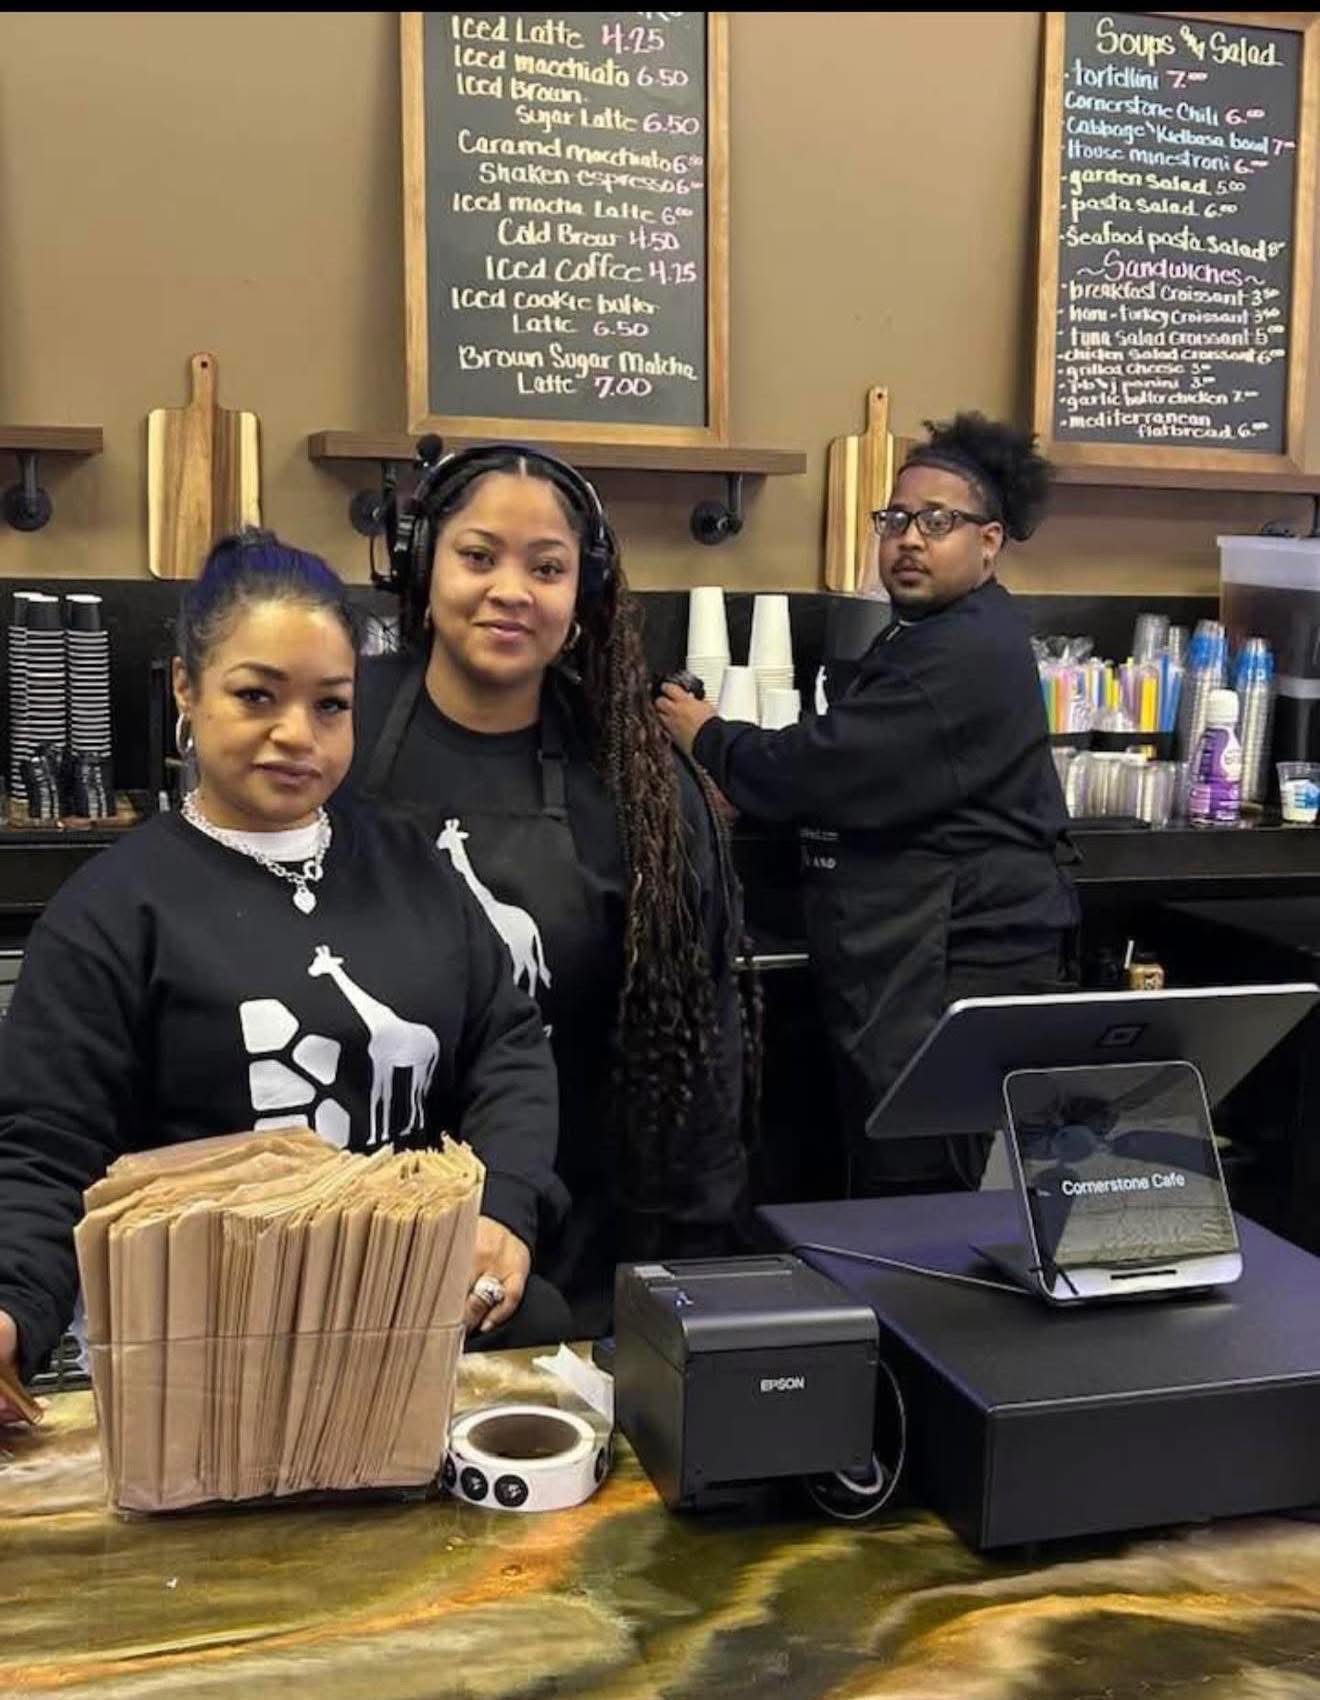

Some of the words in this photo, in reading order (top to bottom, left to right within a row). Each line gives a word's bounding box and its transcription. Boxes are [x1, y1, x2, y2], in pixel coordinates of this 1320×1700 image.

[452, 15, 508, 42] Iced
[516, 18, 585, 50] Latte
[602, 22, 665, 54] 4.25
[1095, 17, 1176, 67] Soups
[1209, 31, 1284, 67] Salad
[455, 45, 505, 69] Iced
[636, 66, 689, 87] 6.50
[456, 72, 502, 98] Iced
[515, 104, 574, 133] Sugar
[580, 107, 638, 132] Latte
[643, 113, 700, 135] 6.50
[458, 129, 561, 158] Caramel
[479, 162, 570, 185] Shaken
[453, 192, 501, 212] Iced
[594, 200, 656, 224] Latte
[499, 218, 550, 246] Cold
[629, 225, 680, 251] 4.50
[486, 255, 547, 280] Iced
[649, 259, 698, 285] 4.25
[1103, 248, 1244, 288] Sandwiches
[451, 287, 506, 310] Iced
[513, 314, 579, 334] Latte
[592, 319, 649, 337] 6.50
[458, 344, 543, 370] Brown
[517, 371, 577, 395] Latte
[594, 375, 652, 399] 7.00
[1061, 1178, 1150, 1197] Cornerstone
[1150, 1172, 1186, 1189] Cafe
[760, 1375, 805, 1393] EPSON
